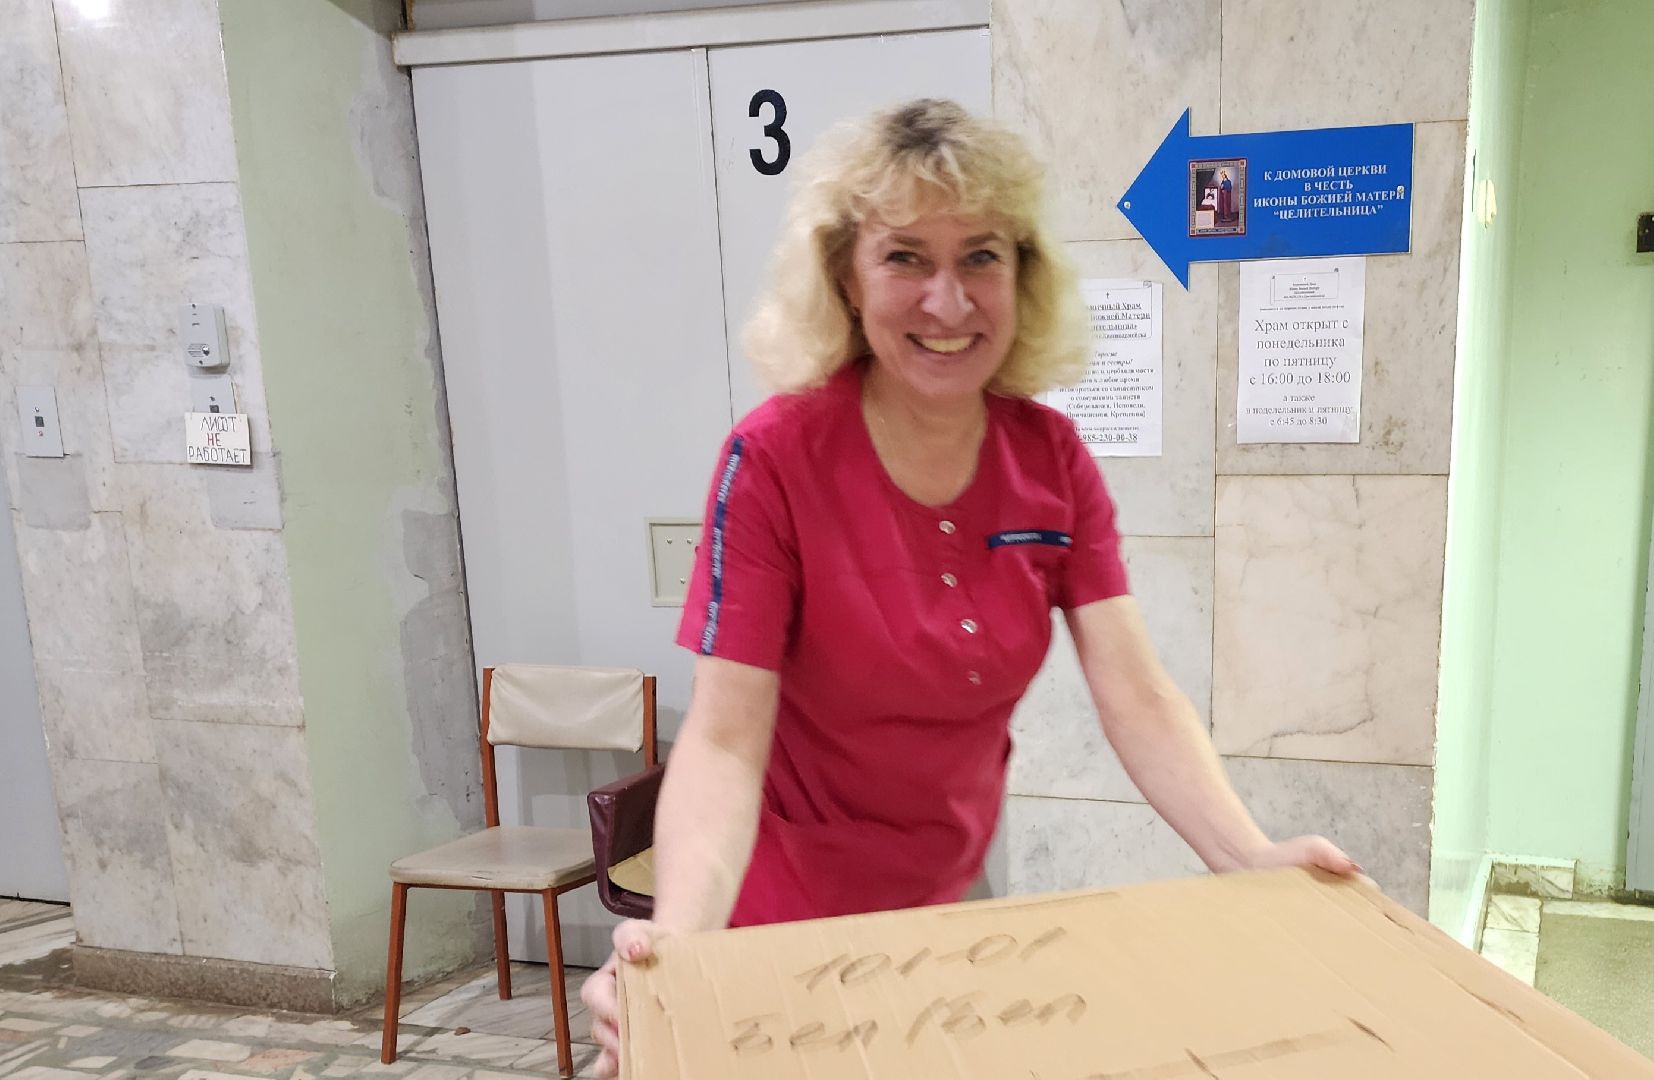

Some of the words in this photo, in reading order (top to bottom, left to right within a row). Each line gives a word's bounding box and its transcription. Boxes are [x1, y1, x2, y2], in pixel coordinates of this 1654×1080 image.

[748, 89, 791, 175] 3
[1264, 170, 1272, 181] К
[1273, 165, 1335, 181] ДОМОВОЙ
[1338, 164, 1387, 177] ЦЕРКВИ
[1304, 181, 1311, 192] В
[1314, 180, 1354, 191] ЧЕСТЬ
[1253, 196, 1298, 208] ИКОНЫ
[1301, 191, 1352, 206] БОЖИЕЙ
[1121, 302, 1142, 311] Храм
[1122, 312, 1151, 320] Матери
[1254, 319, 1289, 334] Храм
[1292, 318, 1339, 333] открыт
[1342, 319, 1350, 329] с
[1256, 337, 1345, 350] понедельника
[1264, 357, 1280, 367] по
[1283, 356, 1337, 369] пятницу
[1249, 375, 1256, 385] с
[1261, 372, 1294, 385] 16:00
[1297, 374, 1313, 386] до
[1317, 371, 1351, 384] 18:00
[1282, 394, 1288, 402] а
[1288, 393, 1316, 402] также
[1252, 406, 1307, 416] понедельник
[1317, 405, 1352, 416] пятницу
[201, 416, 236, 432] ЛИФТ
[1276, 417, 1295, 426] 6:45
[1297, 418, 1307, 426] до
[1309, 416, 1328, 426] 8:30
[207, 432, 222, 447] НЕ
[1078, 433, 1138, 442] -985-230-00-38
[188, 445, 247, 464] РАБОТАЕТ
